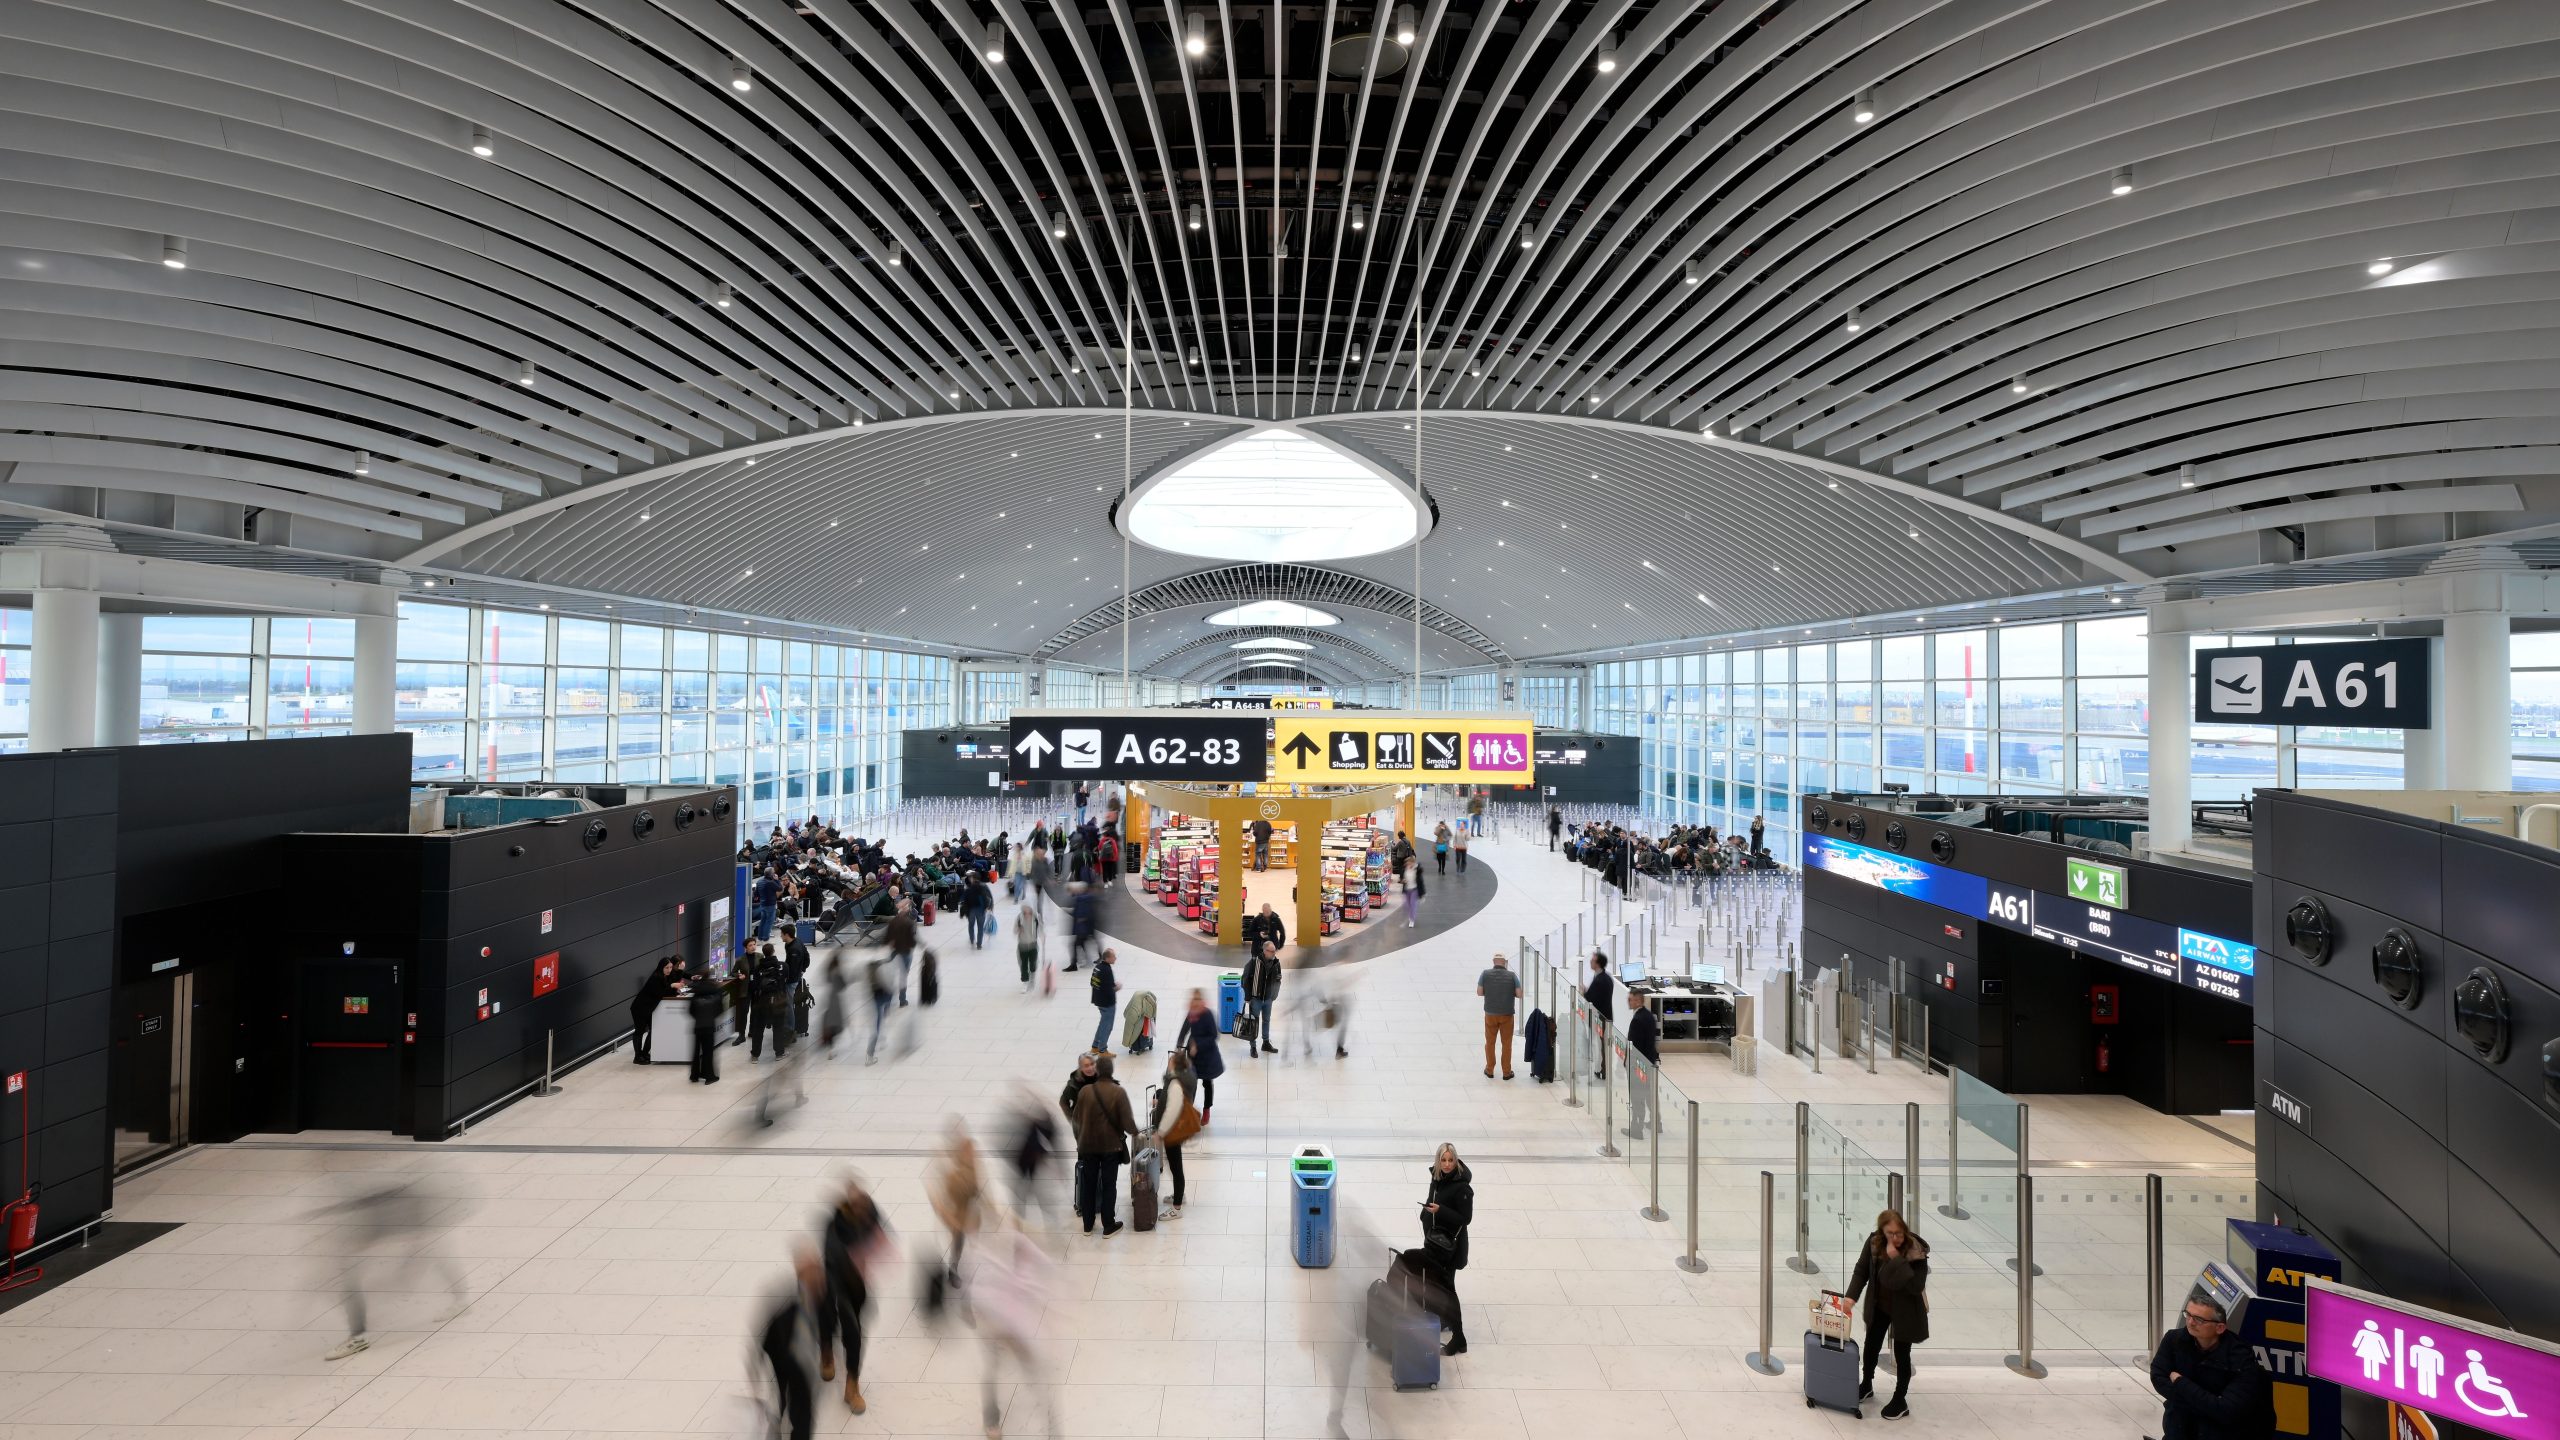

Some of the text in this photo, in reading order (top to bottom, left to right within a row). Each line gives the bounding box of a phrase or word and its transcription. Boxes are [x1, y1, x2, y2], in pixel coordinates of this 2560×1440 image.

[2281, 659, 2397, 709] A61
[1332, 761, 1366, 769] Shopping
[1426, 758, 1457, 766] Smoking
[1988, 892, 2029, 925] A61
[2089, 907, 2111, 922] BARI
[2089, 922, 2111, 938] (BRI)
[2183, 932, 2230, 957] ITA
[2186, 947, 2228, 965] AIRWAYS
[2195, 963, 2240, 984] AZ 01607
[2196, 976, 2240, 999] TP 07236
[2271, 1091, 2302, 1124] ATM
[2266, 1267, 2333, 1287] AT
